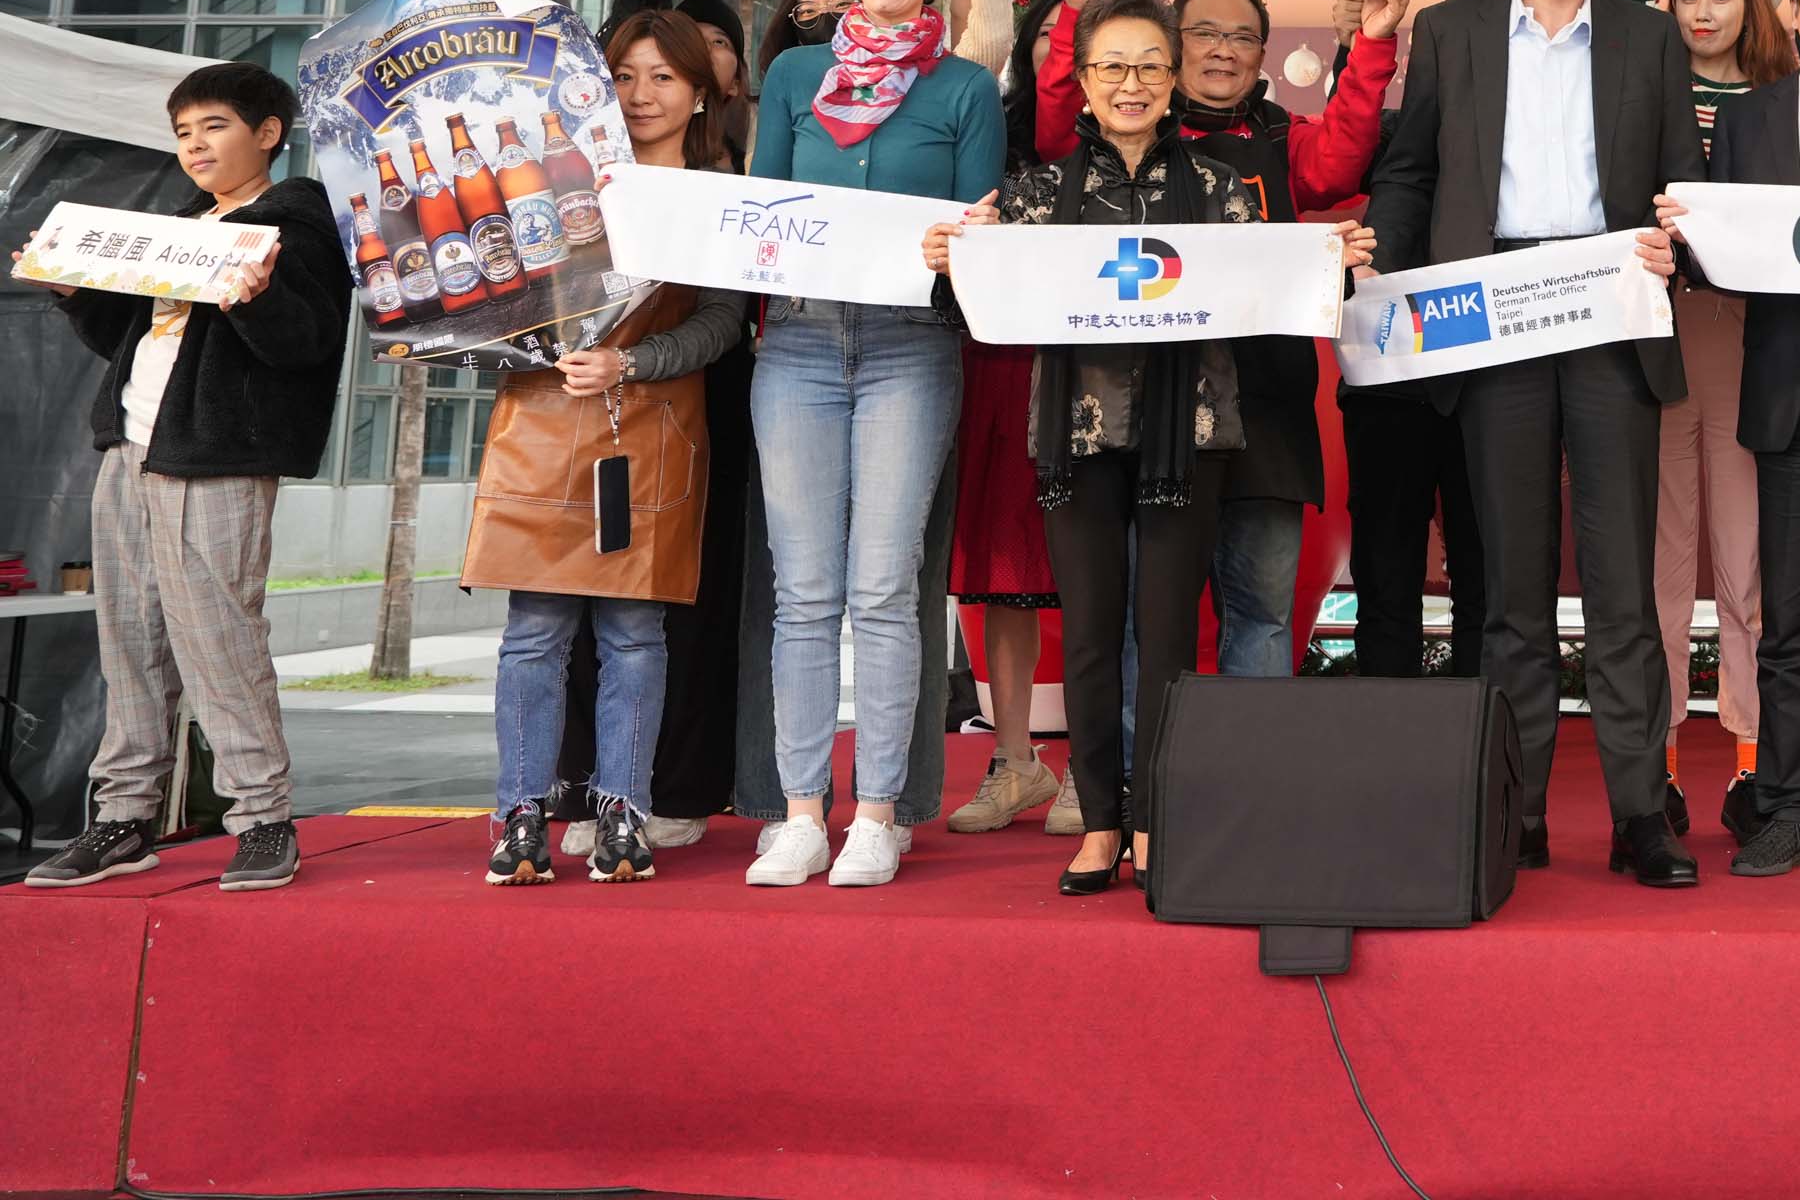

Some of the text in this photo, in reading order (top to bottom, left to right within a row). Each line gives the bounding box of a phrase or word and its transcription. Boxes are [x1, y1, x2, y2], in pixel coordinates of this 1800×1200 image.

[375, 26, 519, 91] Arcobräu
[720, 208, 829, 246] FRANZ
[75, 229, 219, 268] 希臘風 Aiolos
[1492, 265, 1621, 298] Deutsches Wirtschaftsbüro
[1494, 283, 1588, 310] German Trade Office
[1067, 310, 1212, 329] 中德文化經濟協會
[1423, 291, 1482, 322] AHK
[1496, 309, 1524, 322] Taipei
[1499, 307, 1593, 337] 德國經濟辦事處
[1379, 301, 1394, 345] TAIWAN
